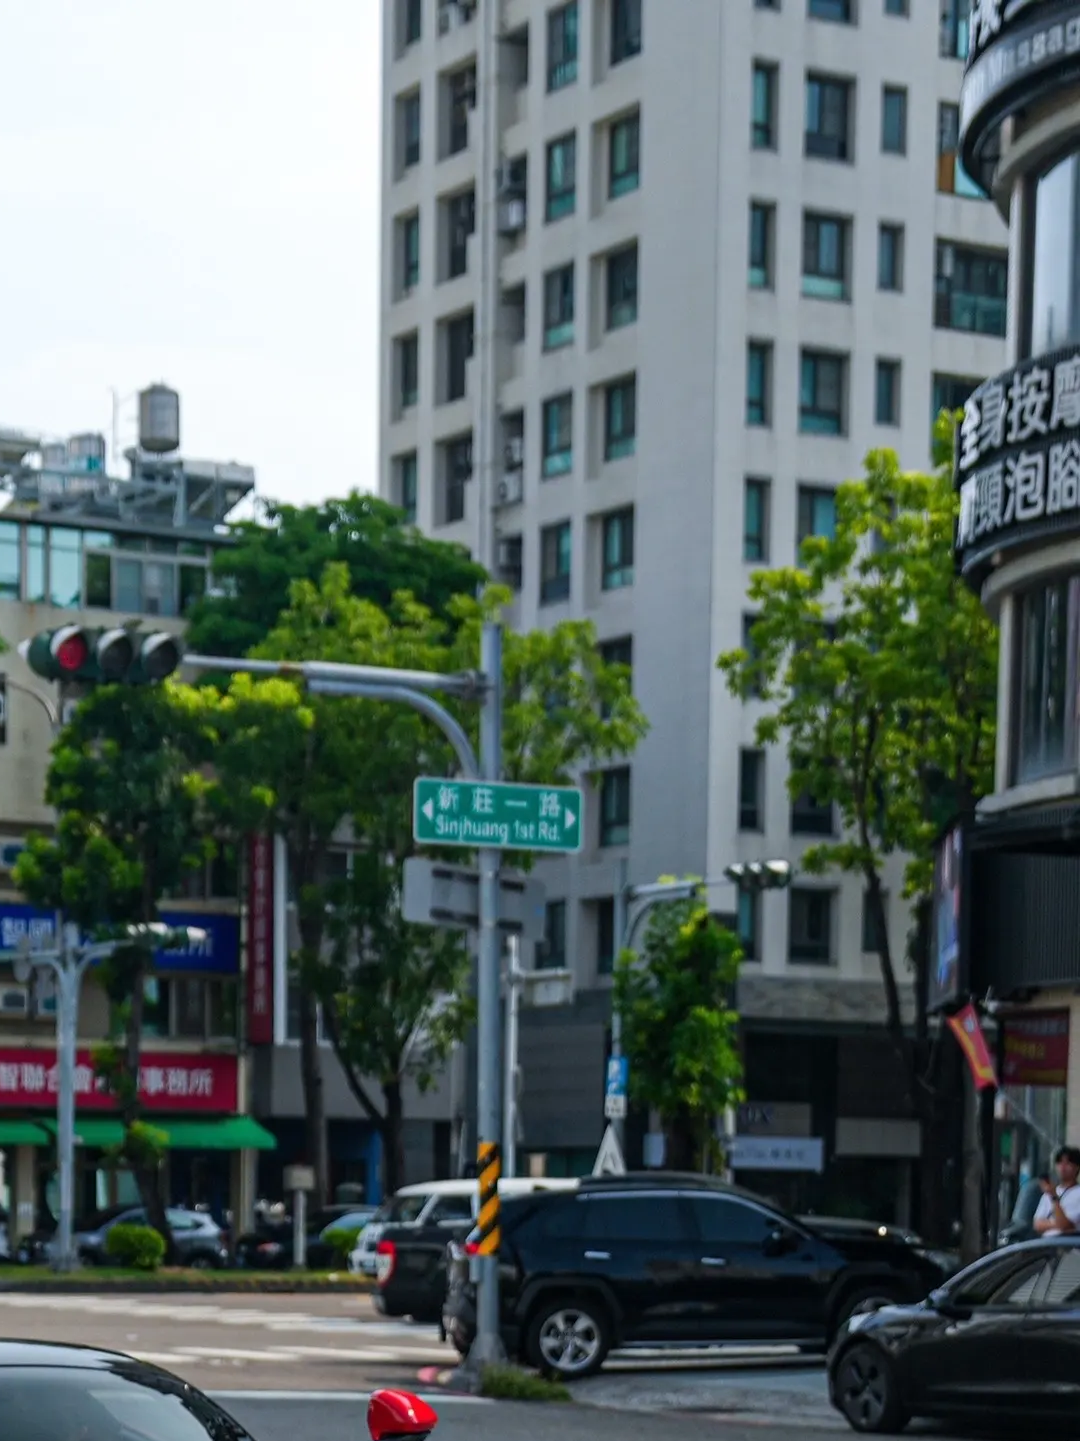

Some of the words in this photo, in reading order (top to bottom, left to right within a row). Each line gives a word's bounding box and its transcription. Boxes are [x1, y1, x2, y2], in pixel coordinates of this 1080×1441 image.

[959, 354, 1080, 470] 全身按摩
[438, 784, 561, 818] 新莊一路
[435, 814, 509, 845] Sinjhuang
[513, 819, 535, 839] 1st
[538, 820, 561, 842] Rd.
